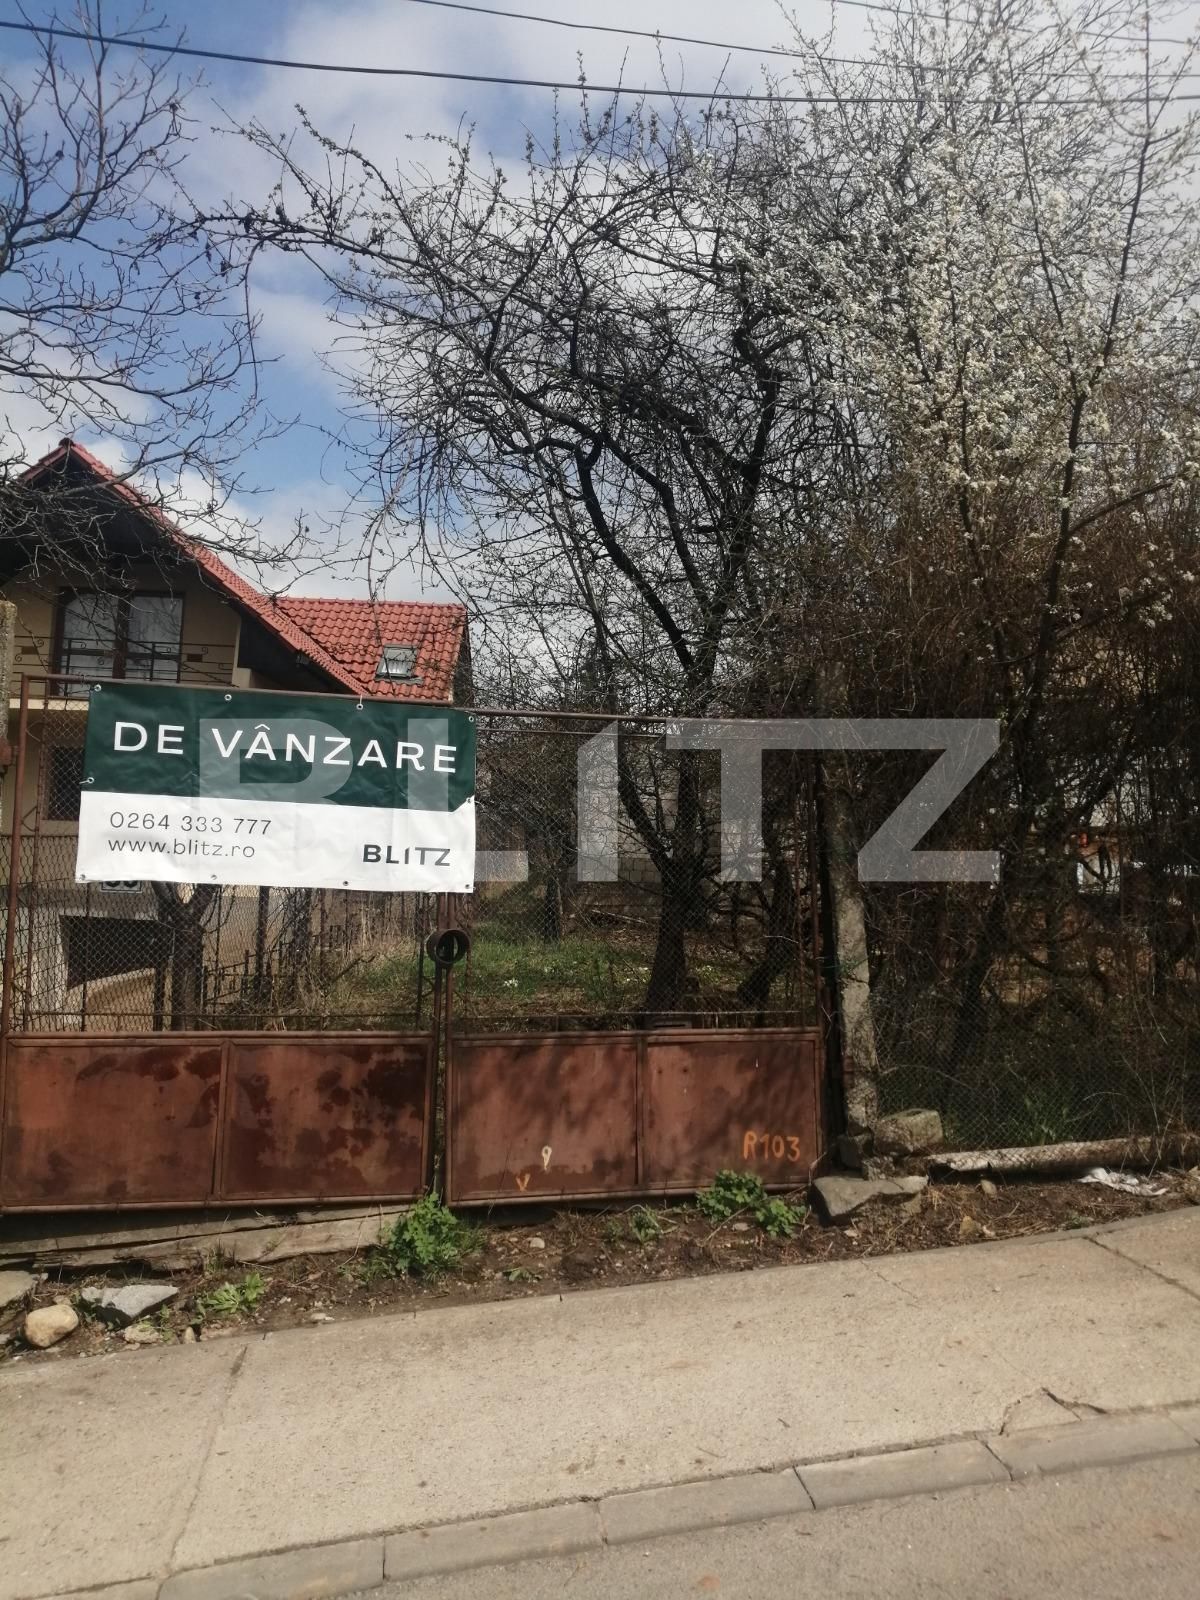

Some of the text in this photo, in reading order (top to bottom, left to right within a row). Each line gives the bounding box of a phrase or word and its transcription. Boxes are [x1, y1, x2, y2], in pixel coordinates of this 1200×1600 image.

[113, 721, 457, 773] DE VÂNZARE
[110, 811, 272, 835] 0264 333 777
[108, 838, 255, 858] www.blitz.ro
[363, 844, 451, 867] BLITZ
[743, 1130, 801, 1162] R103
